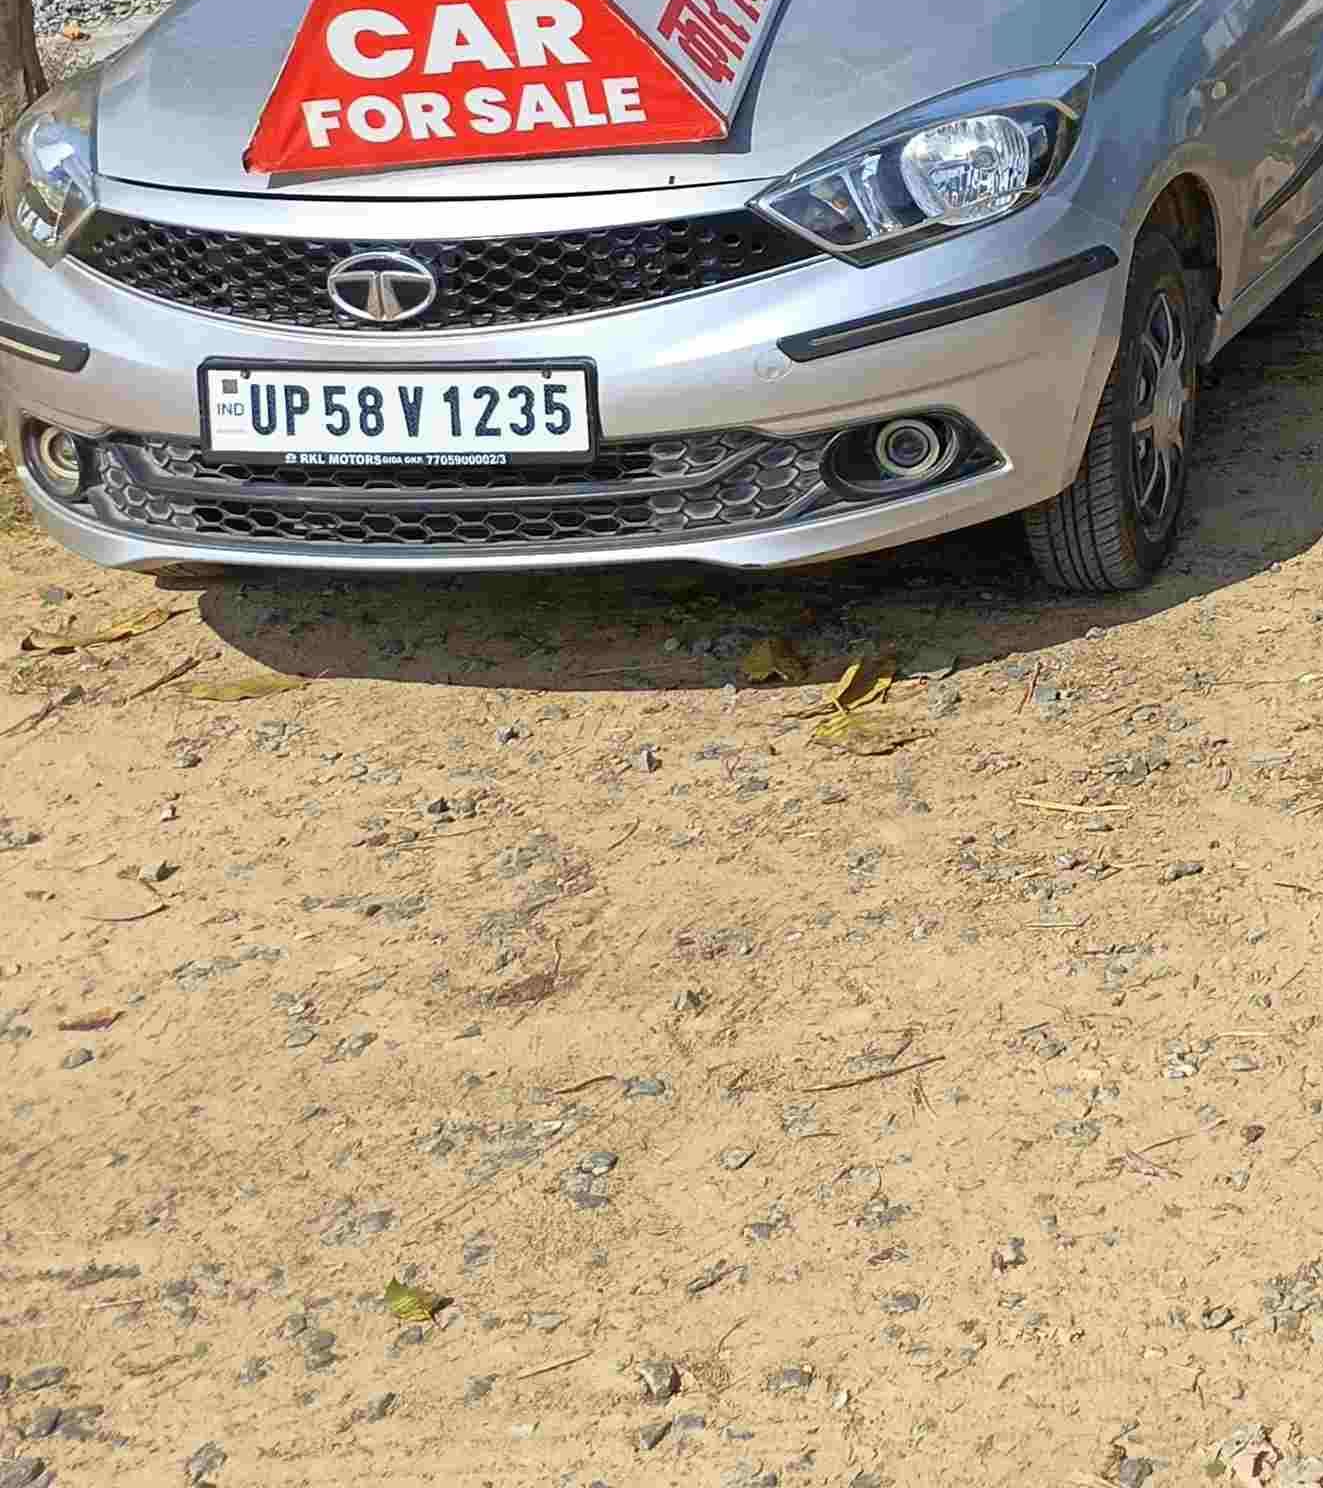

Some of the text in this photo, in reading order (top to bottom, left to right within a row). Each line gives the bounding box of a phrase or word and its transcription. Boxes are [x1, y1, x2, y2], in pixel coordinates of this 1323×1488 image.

[301, 77, 647, 149] FOR SALE
[216, 402, 245, 417] IND
[250, 383, 572, 437] UP 58 V 1235
[299, 452, 326, 465] RKL
[328, 453, 382, 466] MOTORS
